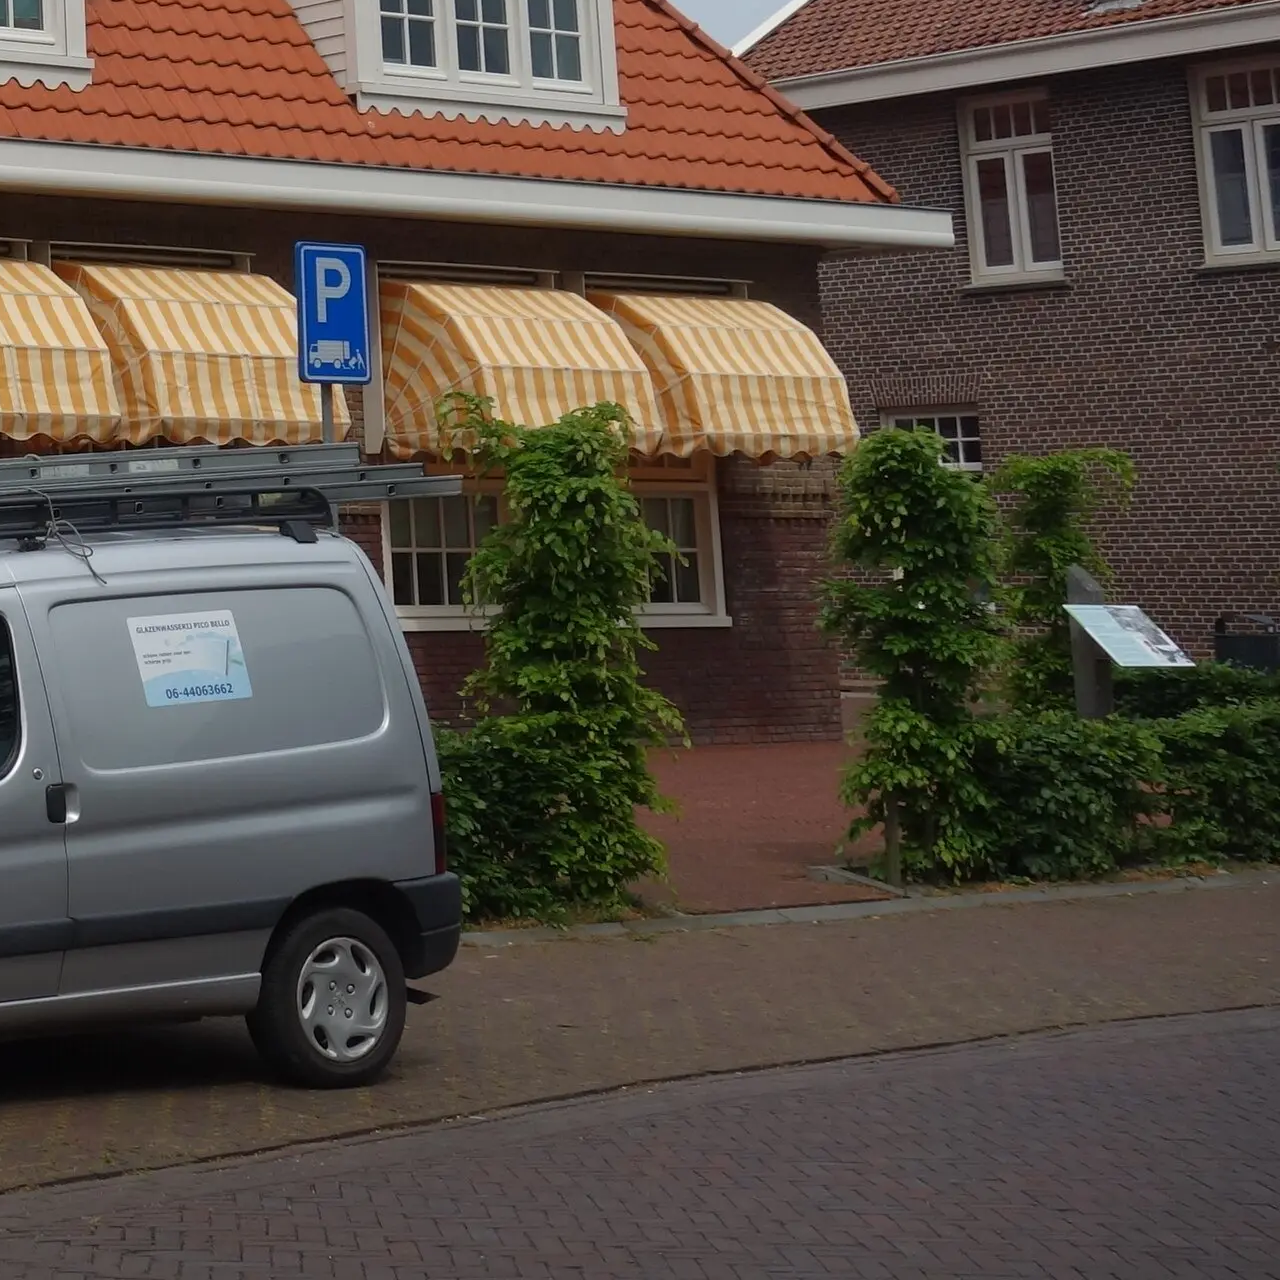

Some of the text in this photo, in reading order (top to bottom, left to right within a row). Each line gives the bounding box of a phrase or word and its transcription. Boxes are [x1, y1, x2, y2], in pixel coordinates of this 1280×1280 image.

[315, 256, 352, 323] P
[135, 619, 230, 634] GLAZENWASSERIJ PICO BELLO
[165, 683, 234, 699] 06-44063662
